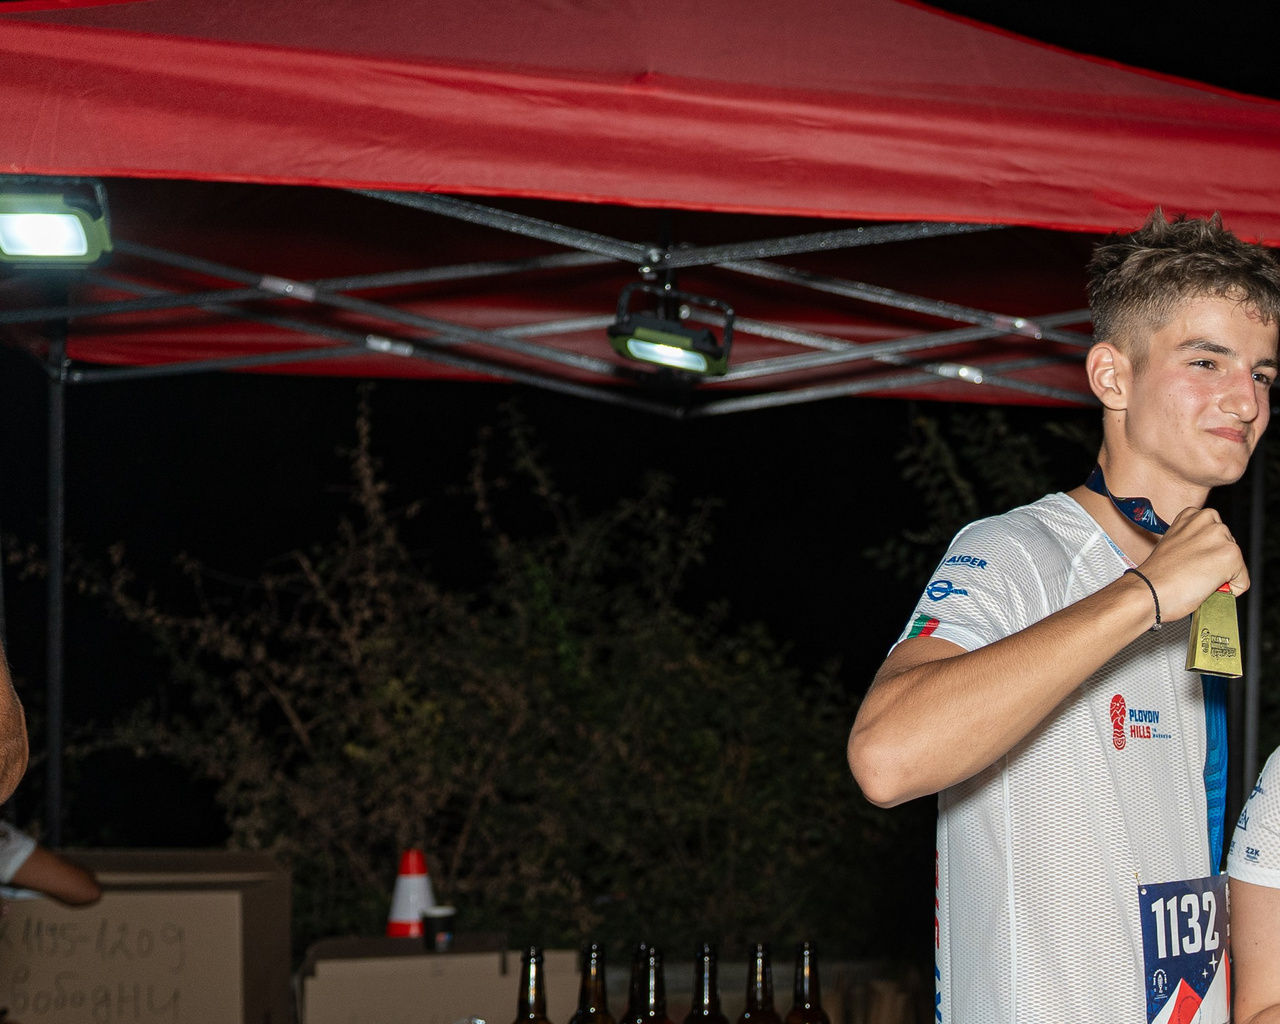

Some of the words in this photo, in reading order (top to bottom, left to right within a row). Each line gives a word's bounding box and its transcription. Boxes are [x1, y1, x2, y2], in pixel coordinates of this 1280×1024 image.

[1128, 708, 1160, 724] PLOVDIV
[1130, 725, 1151, 739] HILLS
[1245, 846, 1260, 857] 22K
[1151, 891, 1220, 959] 1132
